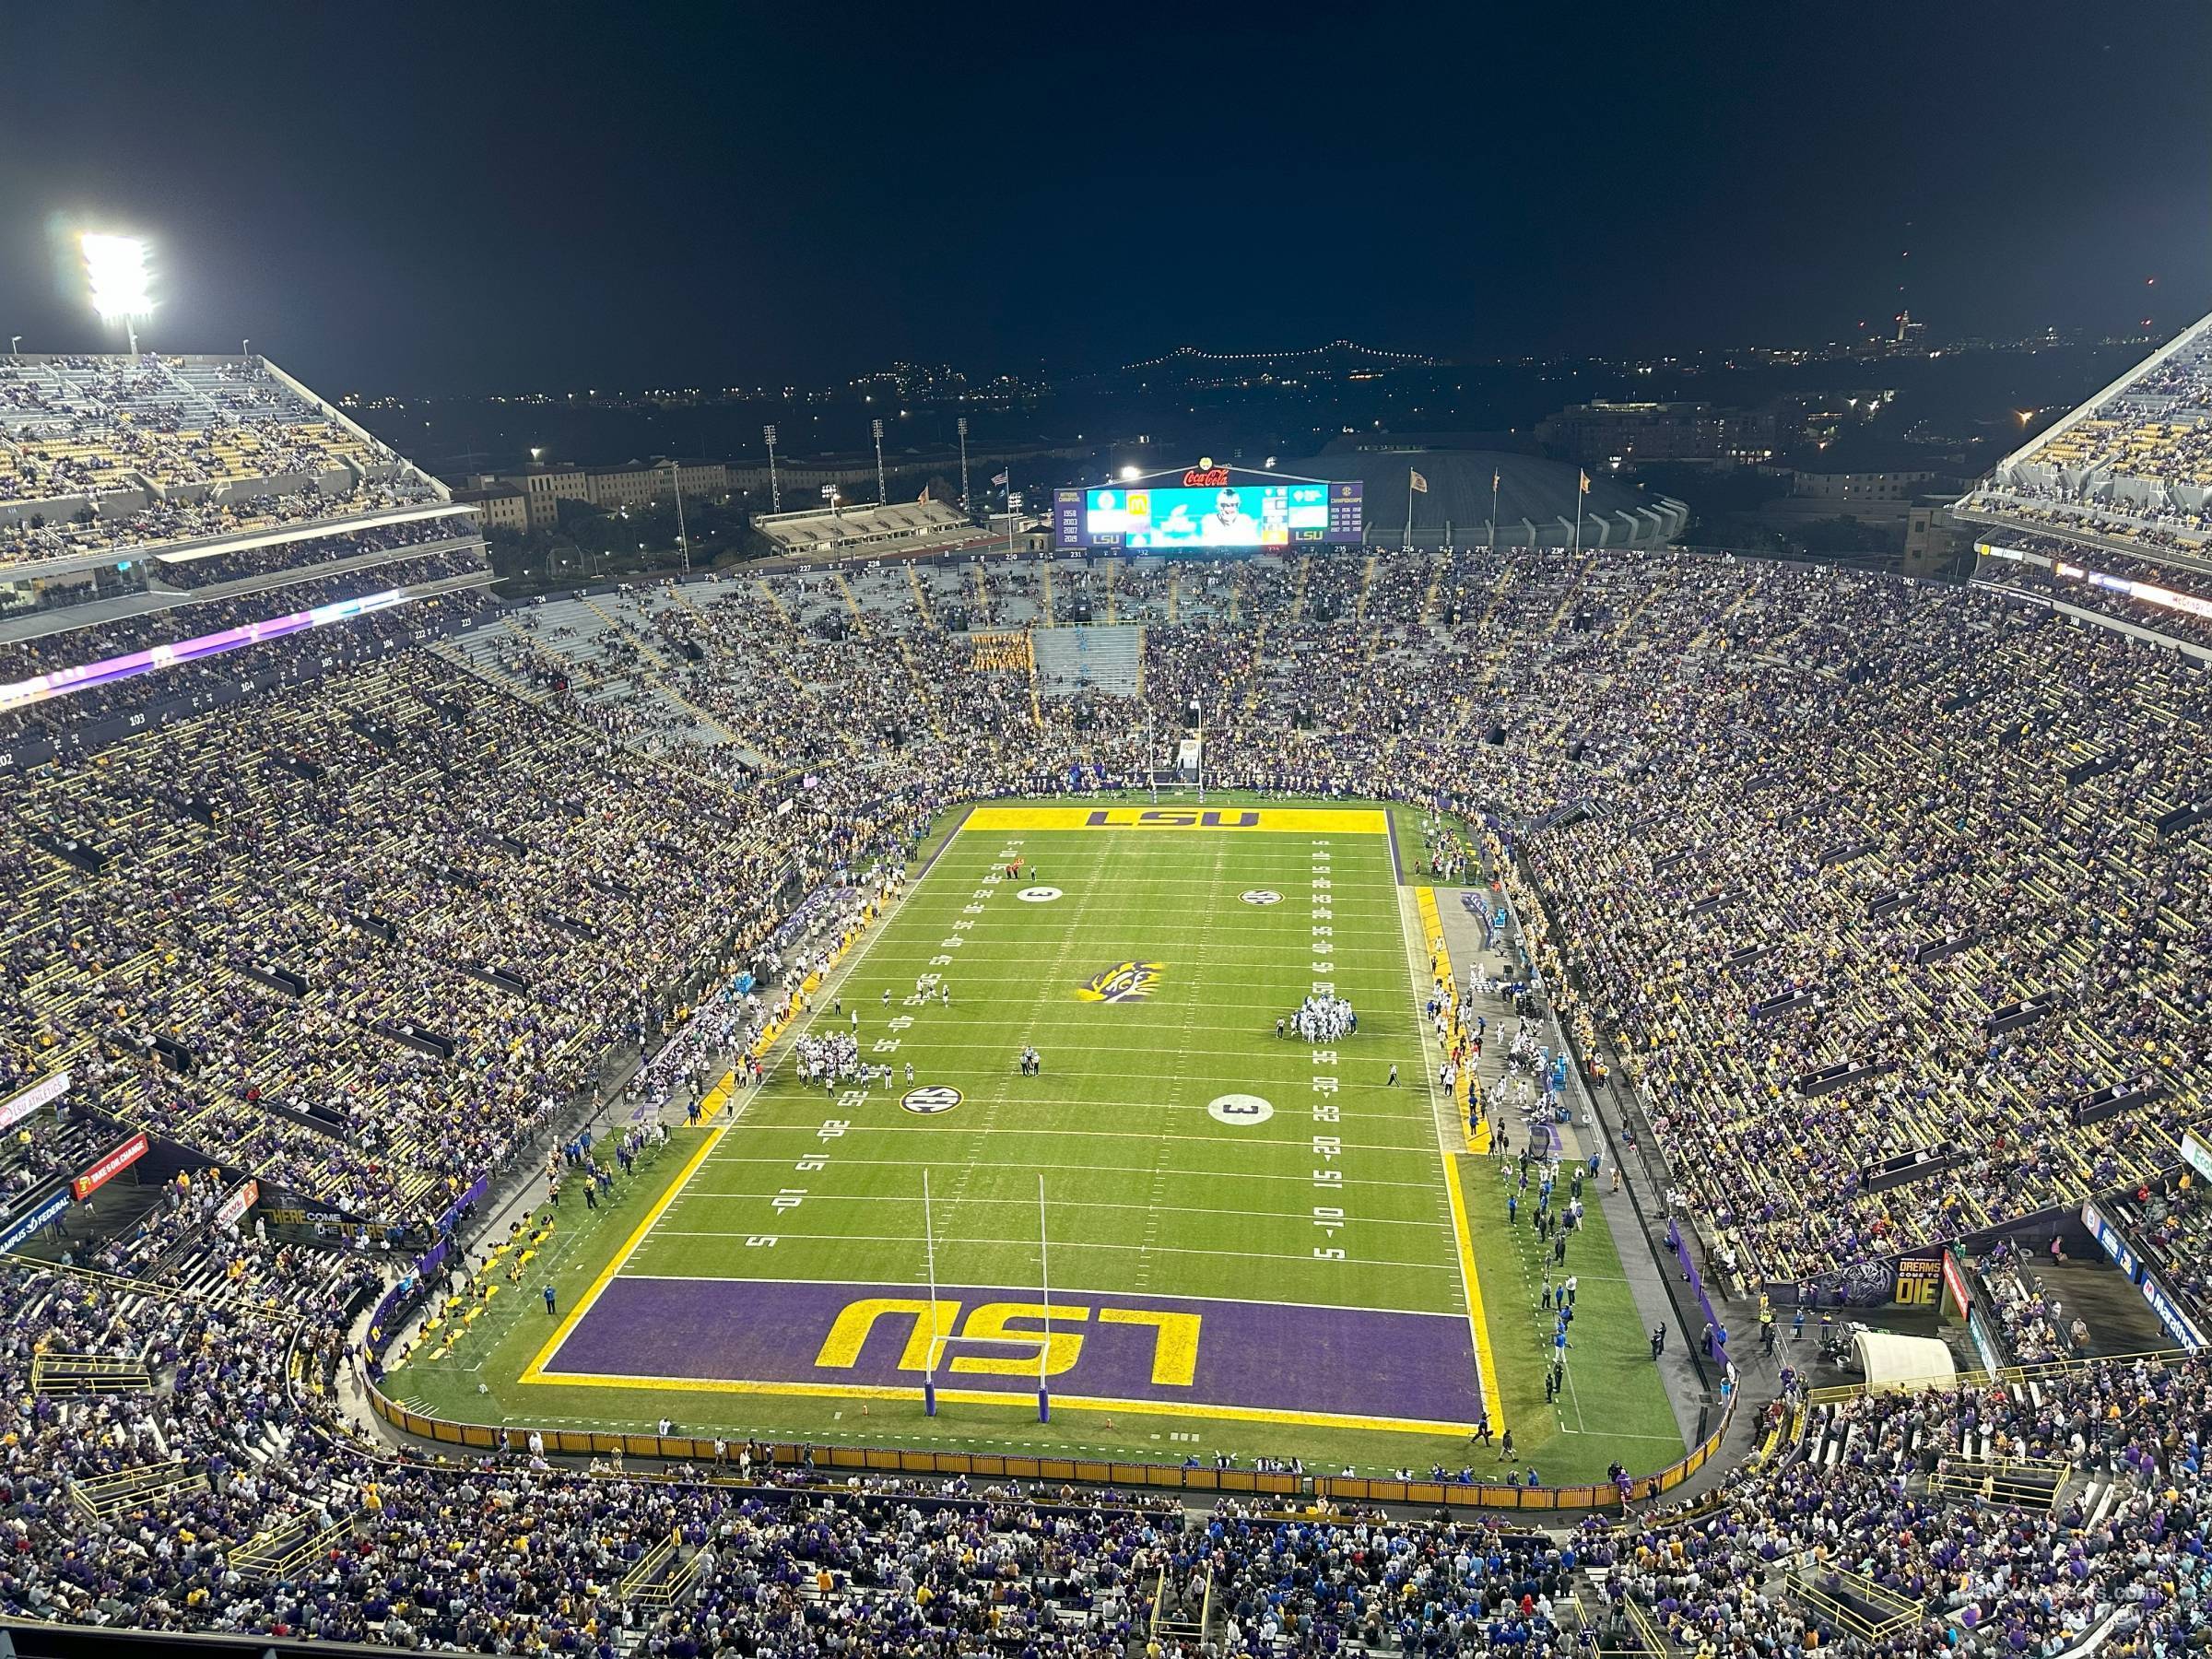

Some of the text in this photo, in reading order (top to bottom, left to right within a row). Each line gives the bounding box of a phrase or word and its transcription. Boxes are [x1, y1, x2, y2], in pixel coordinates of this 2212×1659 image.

[1183, 469, 1229, 487] Coca-Cola
[1093, 535, 1120, 544] LSU
[1295, 531, 1324, 541] LSU
[1815, 565, 1827, 573] 241
[1902, 577, 1914, 586] 242
[461, 618, 471, 628] 223
[415, 629, 426, 640] 222
[383, 638, 394, 649] 106
[321, 656, 333, 667] 105
[241, 680, 255, 692] 104
[129, 713, 146, 726] 103
[0, 753, 14, 768] 02
[1085, 811, 1260, 827] LSU
[1312, 962, 1335, 973] 45
[872, 1039, 901, 1053] 35
[1312, 1050, 1337, 1065] 35
[1312, 1077, 1339, 1092] 30
[12, 1101, 27, 1116] LSU
[29, 1080, 64, 1107] ATHLETICS
[837, 1090, 869, 1107] 25
[902, 1086, 961, 1113] SEC
[1223, 1104, 1259, 1113] 3
[1312, 1105, 1340, 1122] 25
[817, 1120, 851, 1137] 20
[1312, 1135, 1341, 1155] 20
[91, 1166, 107, 1183] TAKE
[121, 1139, 145, 1165] CHANGE
[794, 1154, 830, 1171] 15
[1312, 1170, 1343, 1188] 15
[771, 1188, 808, 1207] 10
[38, 1197, 69, 1225] FEDERAL
[306, 1213, 341, 1222] COME
[1313, 1206, 1345, 1228] 10
[340, 1223, 385, 1239] TIGRS
[745, 1236, 779, 1247] 5
[1313, 1247, 1346, 1259] 5
[1900, 1262, 1941, 1272] DREAMS
[1896, 1277, 1938, 1304] DIE
[2153, 1293, 2198, 1355] Marathon
[814, 1298, 1202, 1386] LSU
